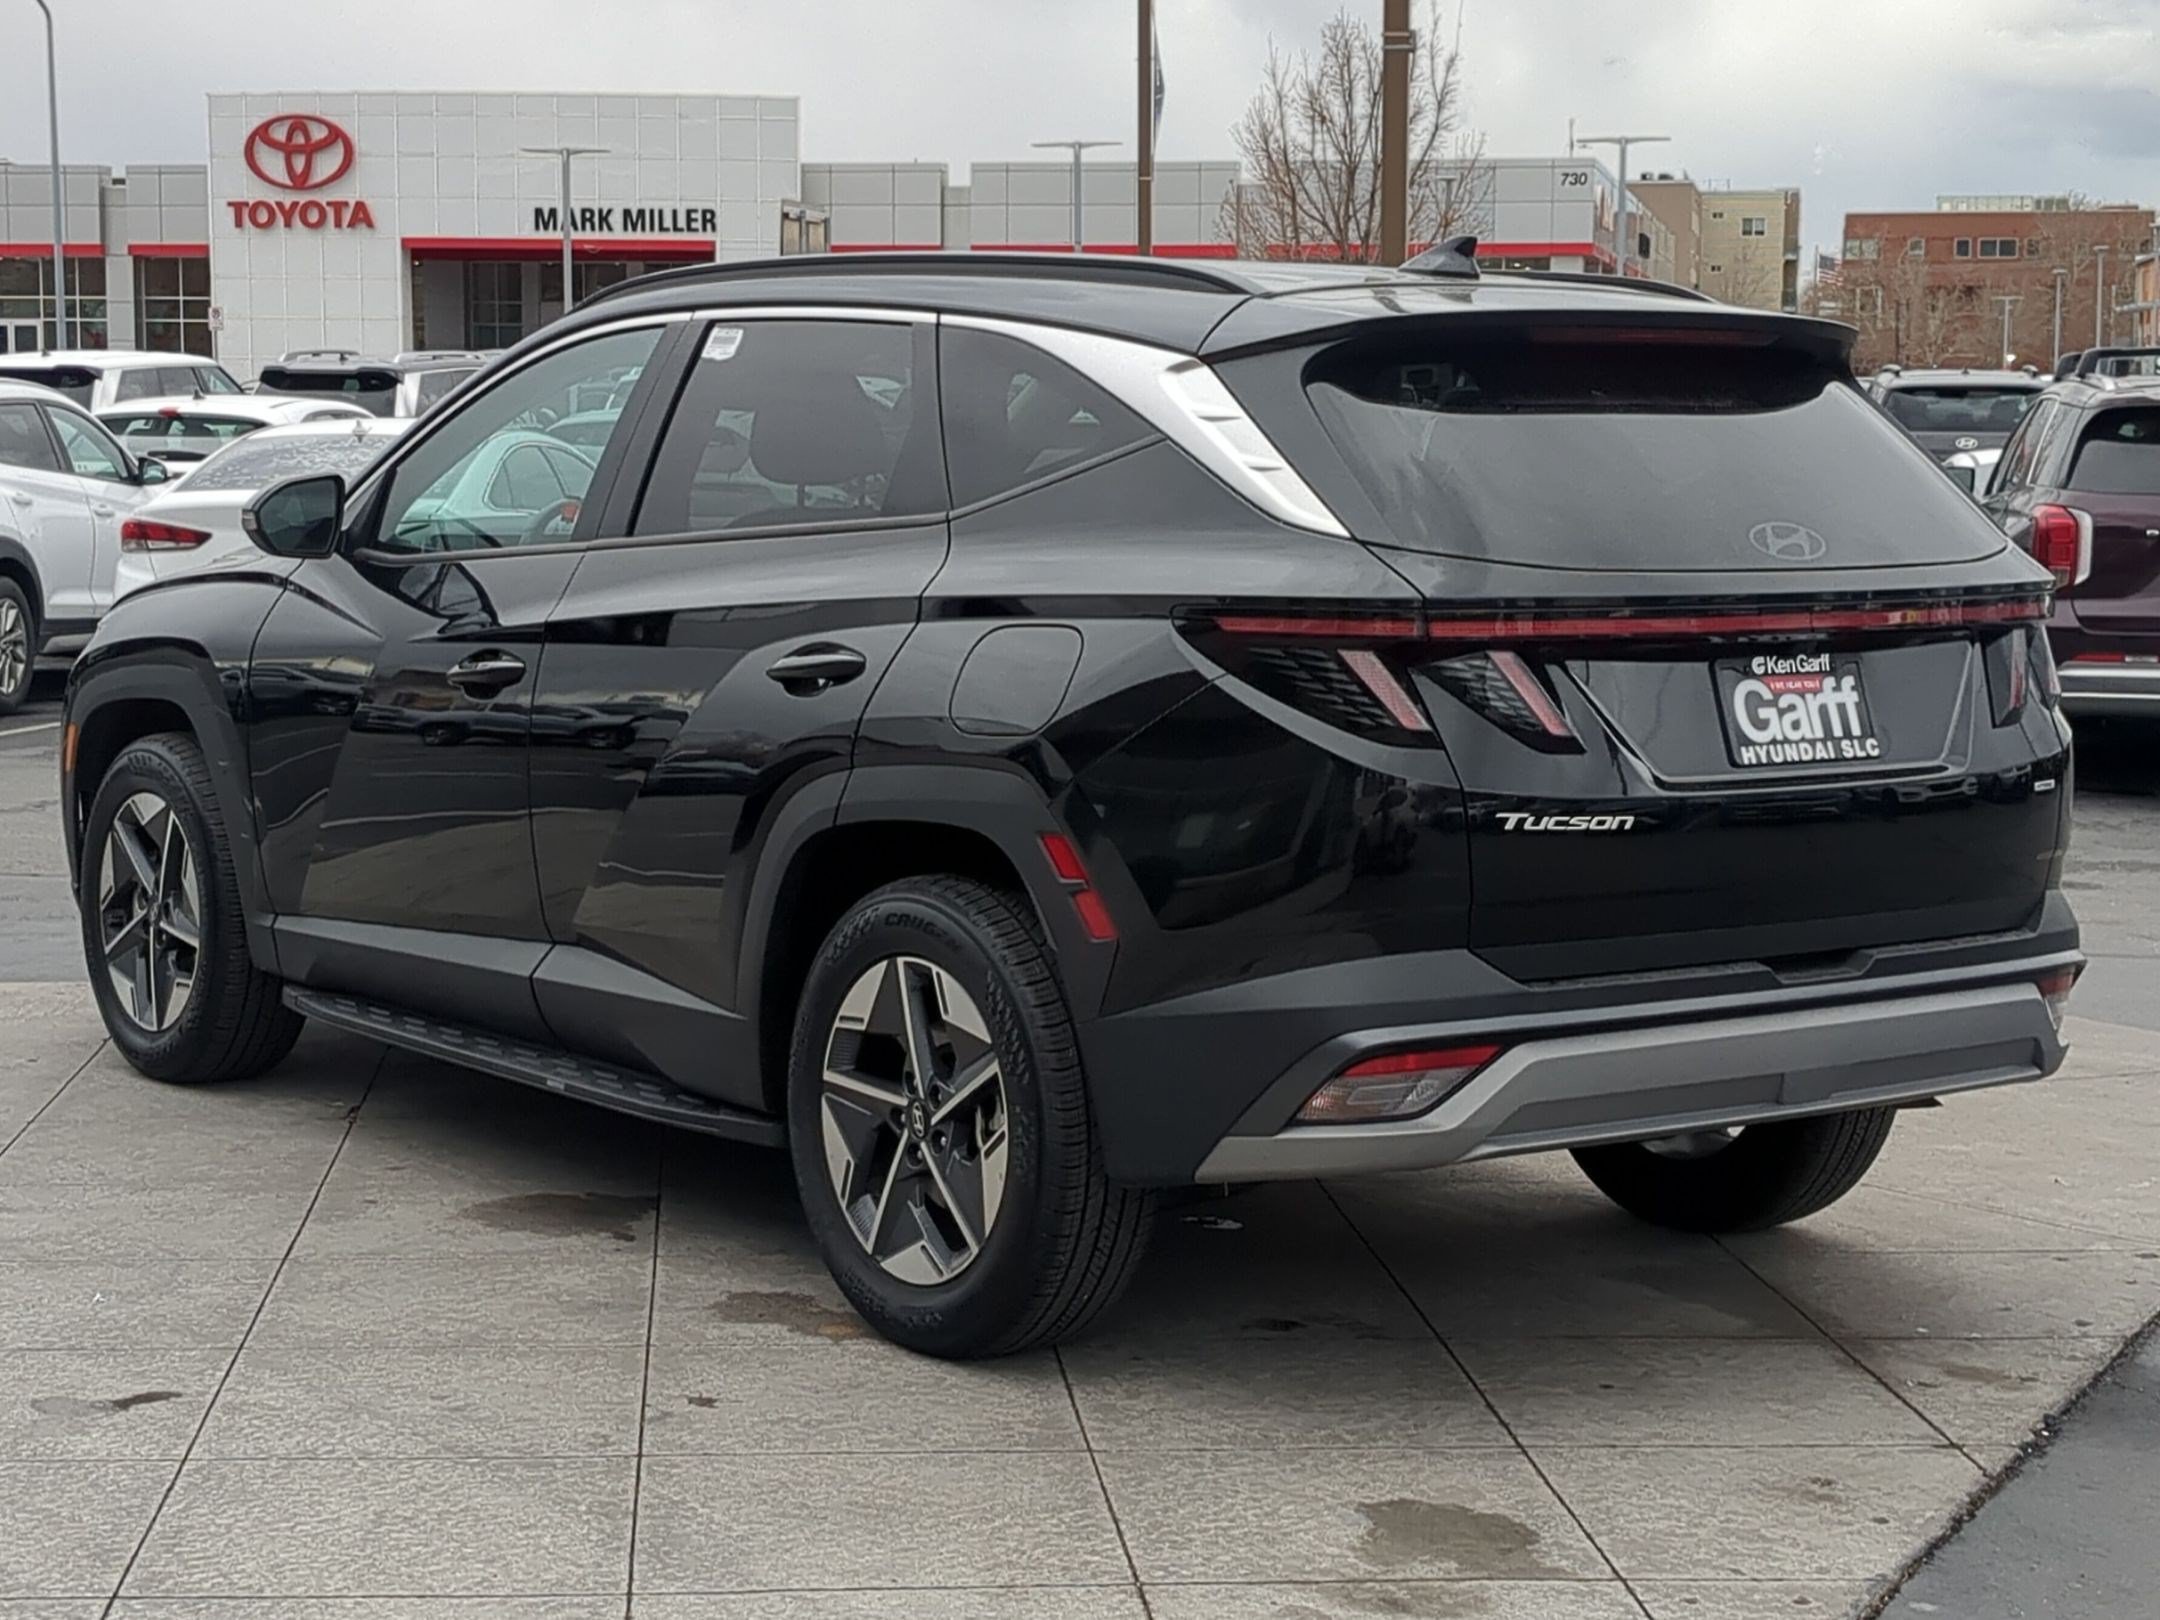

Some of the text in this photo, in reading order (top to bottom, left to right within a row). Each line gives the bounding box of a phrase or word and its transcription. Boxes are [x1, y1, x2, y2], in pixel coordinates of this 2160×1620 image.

[1561, 172, 1588, 186] 730
[227, 200, 375, 230] TOYOTA
[534, 207, 717, 233] MARK MILLER
[1767, 653, 1831, 674] Ken Garff
[1733, 675, 1862, 743] Garff
[1740, 737, 1880, 765] HYUNDAI SLC
